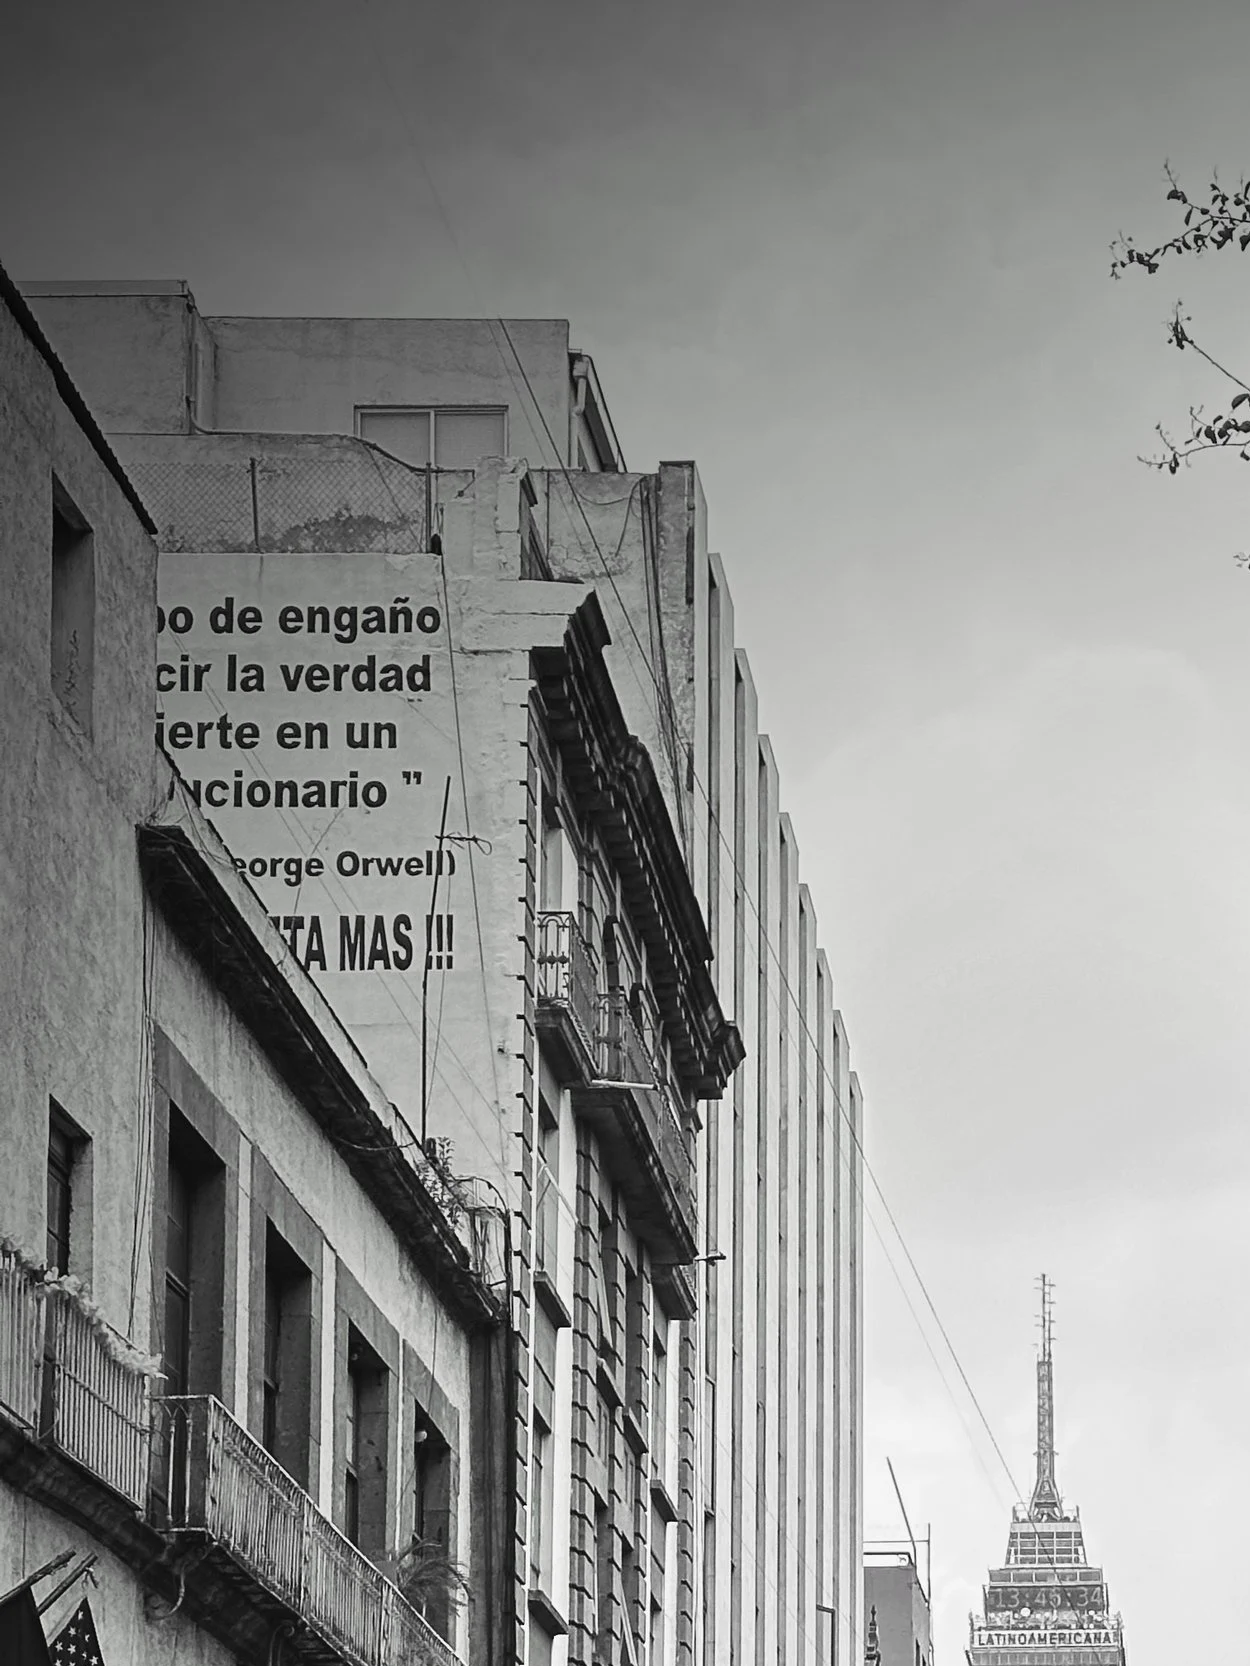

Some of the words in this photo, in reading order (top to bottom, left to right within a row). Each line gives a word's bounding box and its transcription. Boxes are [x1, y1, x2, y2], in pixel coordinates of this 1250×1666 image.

[209, 597, 263, 634] de
[278, 597, 442, 644] engaño
[227, 654, 265, 692] la
[280, 654, 432, 692] verdad
[276, 722, 329, 750] en
[346, 722, 398, 750] un
[339, 914, 413, 972] MAS
[978, 1632, 1113, 1646] LATINOAMERICANA
